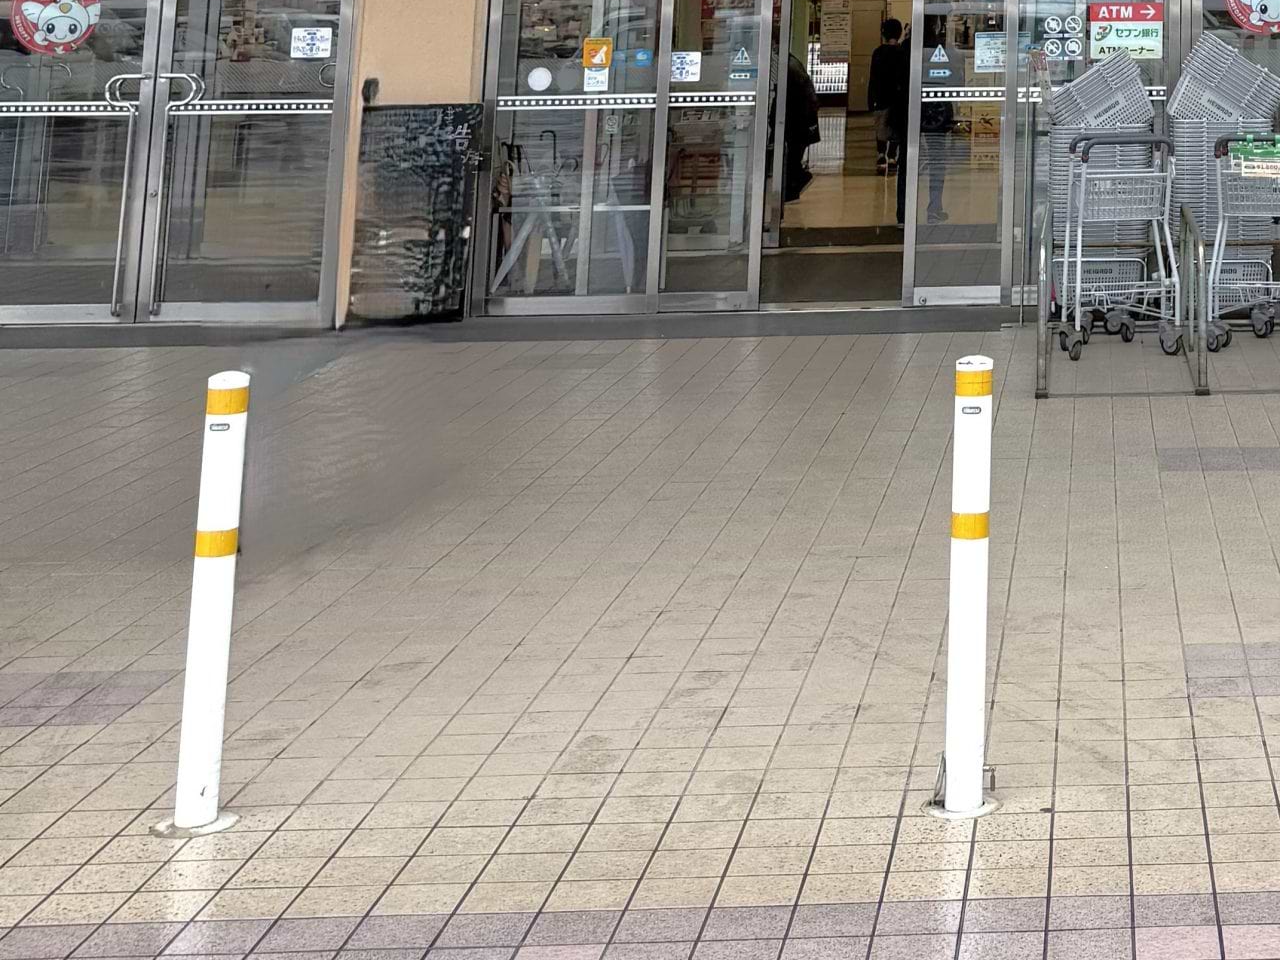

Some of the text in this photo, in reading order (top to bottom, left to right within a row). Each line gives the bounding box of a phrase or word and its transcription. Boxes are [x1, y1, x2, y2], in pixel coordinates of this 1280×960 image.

[1098, 6, 1133, 19] ATM
[1115, 28, 1159, 38] セブン銀行
